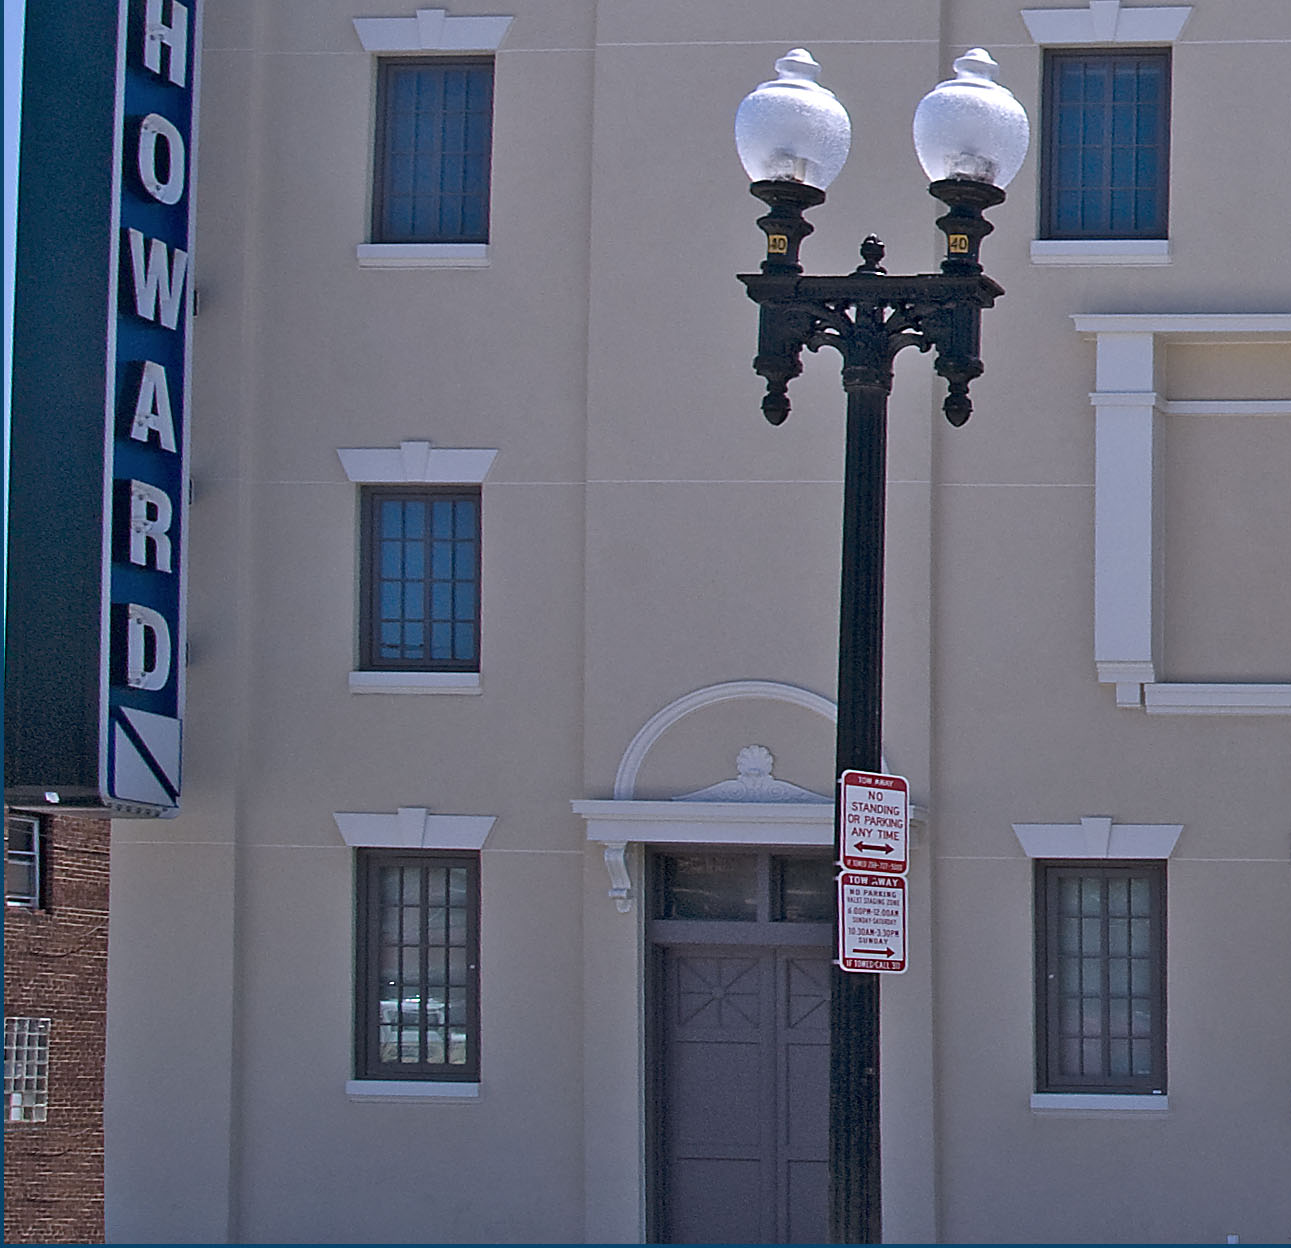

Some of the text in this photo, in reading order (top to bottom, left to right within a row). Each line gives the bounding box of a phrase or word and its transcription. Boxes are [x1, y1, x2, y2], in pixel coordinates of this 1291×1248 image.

[770, 237, 786, 251] 40
[951, 236, 968, 251] 40
[868, 791, 883, 801] NO
[852, 802, 900, 815] STANDING
[848, 814, 904, 829] OR PARKING
[851, 827, 900, 841] ANY TIME
[848, 875, 899, 886] TOW AWAY
[863, 890, 897, 898] PARKING
